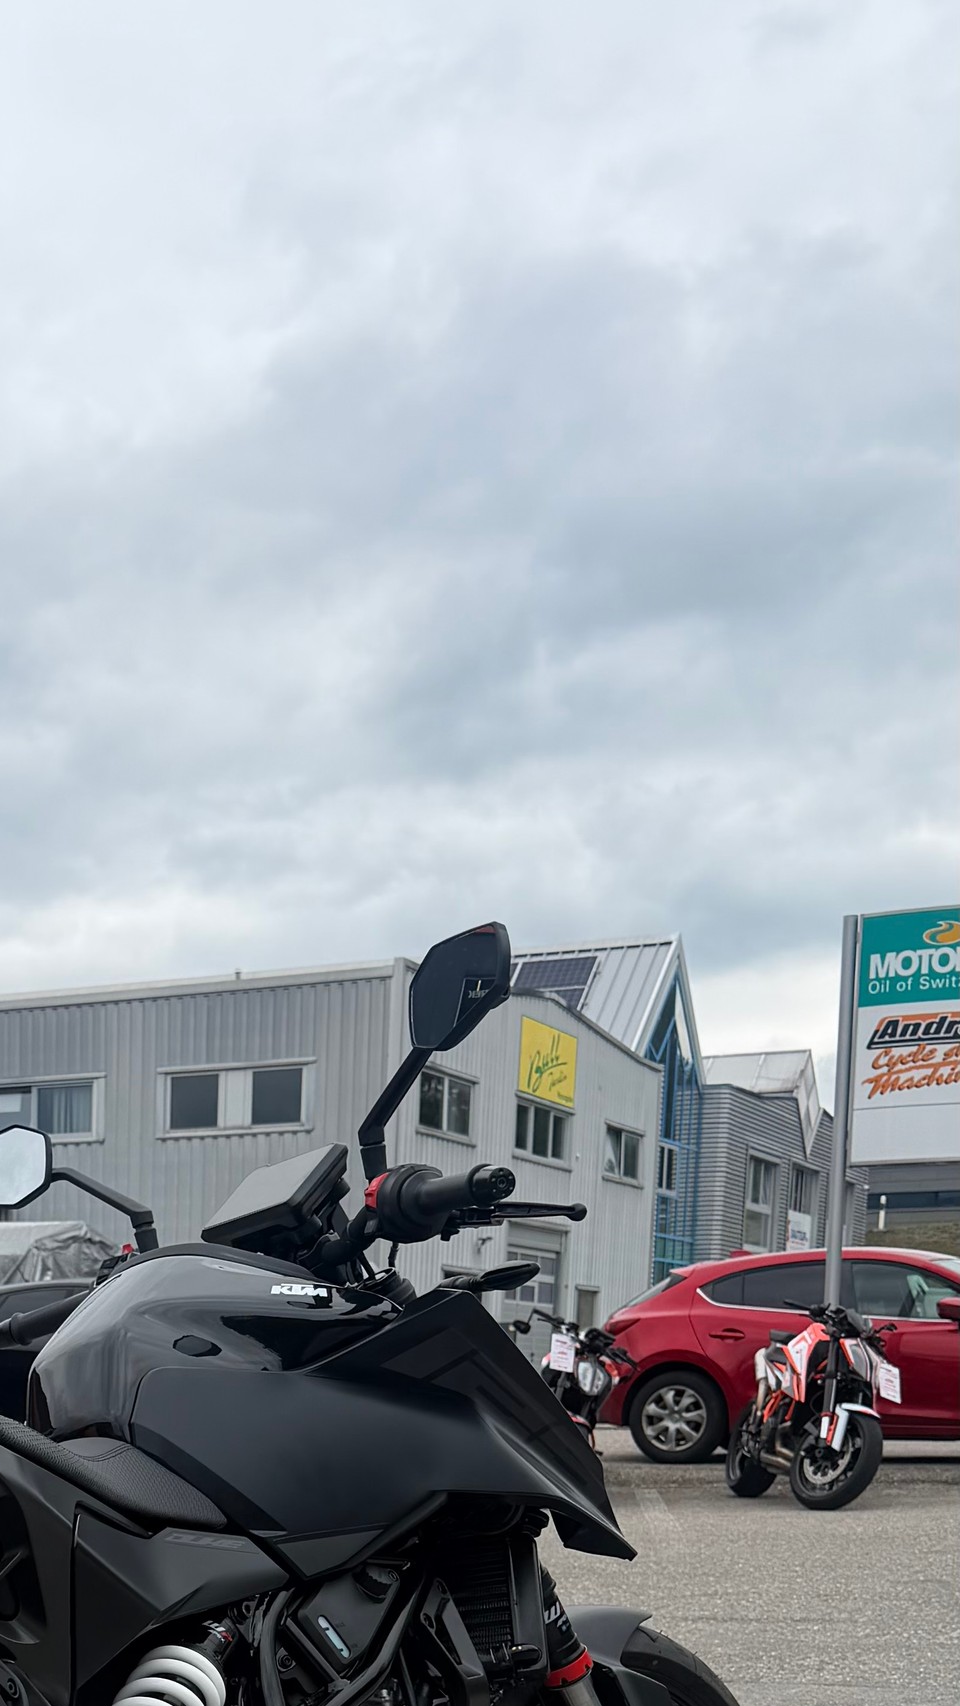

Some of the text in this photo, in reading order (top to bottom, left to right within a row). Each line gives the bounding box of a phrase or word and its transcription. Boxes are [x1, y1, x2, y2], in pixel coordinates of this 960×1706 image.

[868, 975, 960, 994] Oil of Swit
[877, 1016, 960, 1039] Andr
[871, 1043, 938, 1072] Cycle
[271, 1283, 328, 1297] KTM
